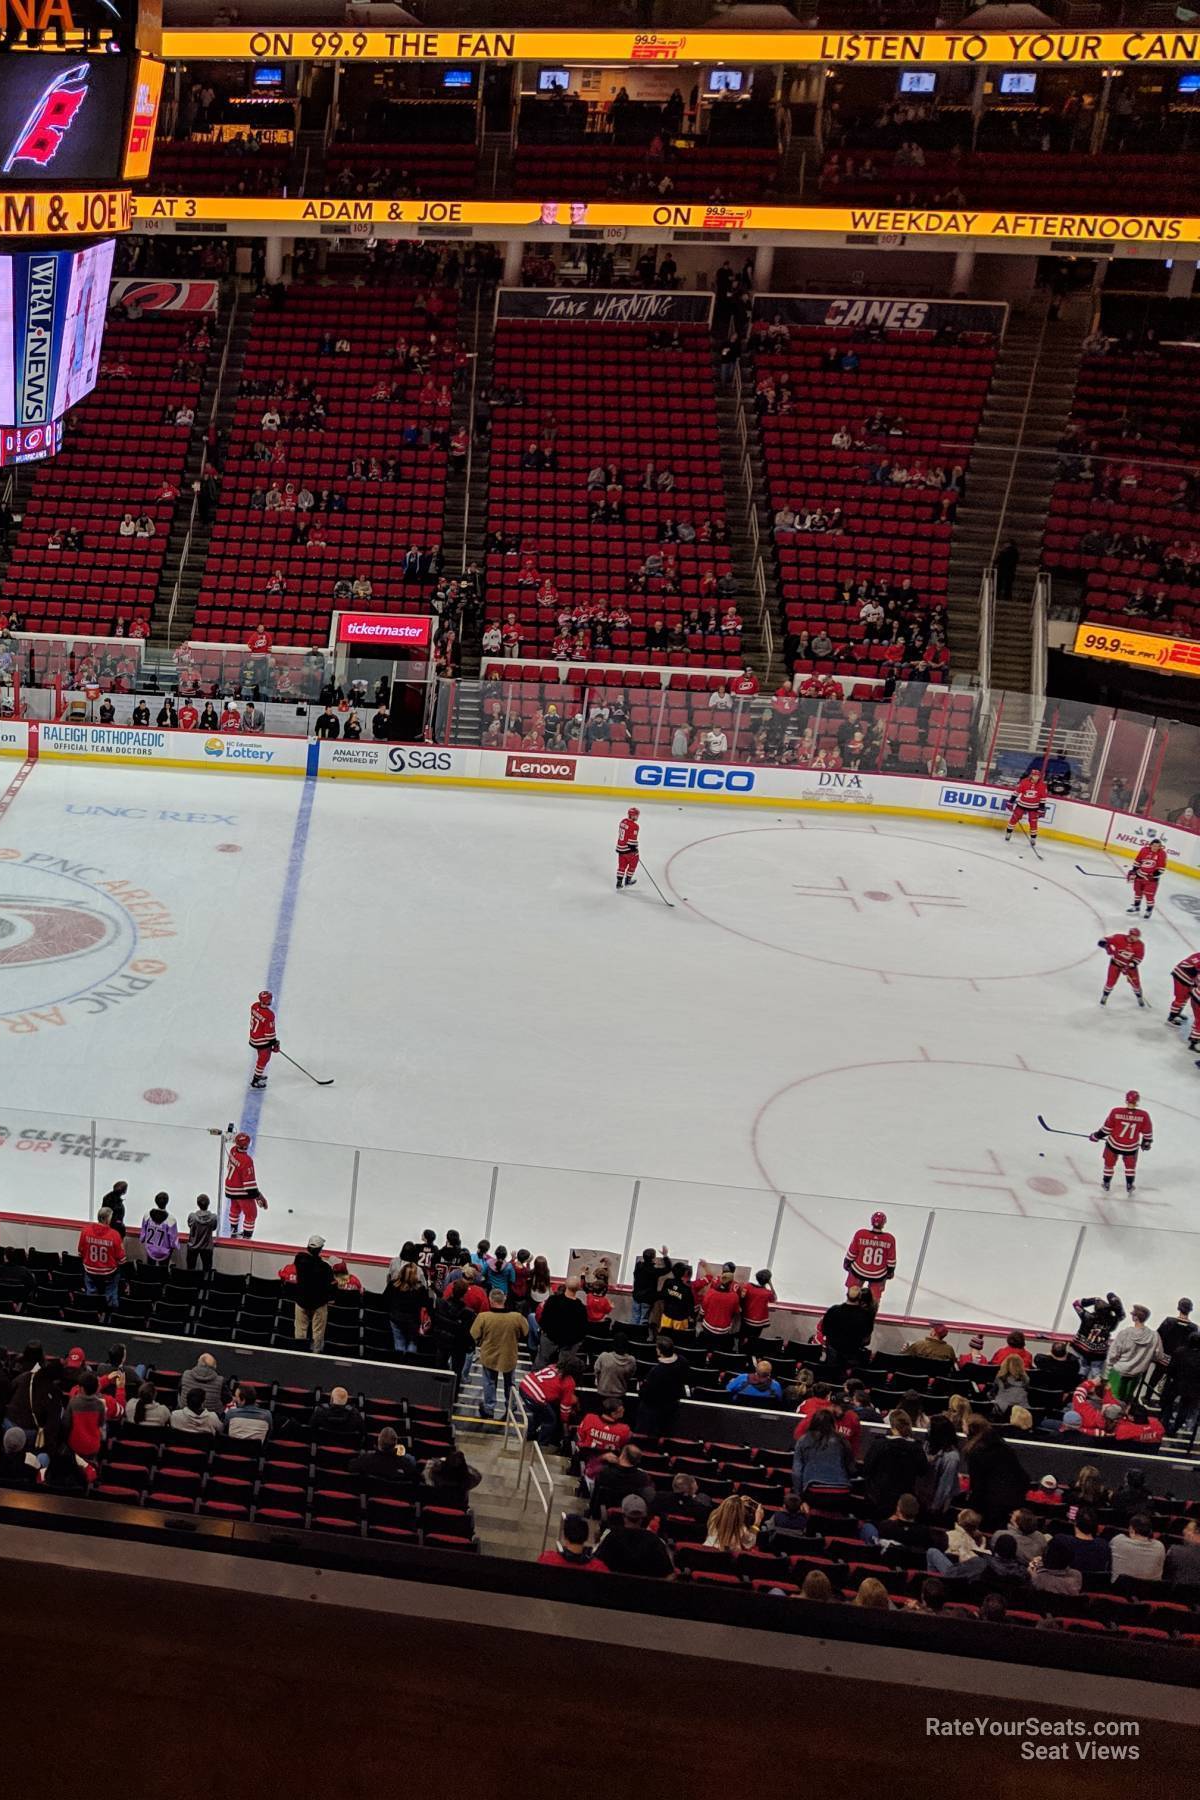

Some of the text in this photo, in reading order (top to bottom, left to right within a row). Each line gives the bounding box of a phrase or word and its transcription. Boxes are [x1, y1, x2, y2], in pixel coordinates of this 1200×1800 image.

[249, 33, 516, 57] ON 99.9 THE FAN
[819, 35, 926, 60] LISTEN
[944, 34, 988, 60] TO
[1007, 34, 1102, 60] YOUR
[46, 194, 69, 231] &
[76, 194, 117, 231] JOE
[152, 199, 178, 216] AT
[185, 199, 196, 217] 3
[302, 202, 462, 222] ADAM & JOE
[653, 207, 691, 226] ON
[851, 211, 1181, 240] WEEKDAY AFTERNOONS
[824, 300, 930, 328] CANES
[25, 259, 54, 420] WRAL NEWS
[347, 623, 423, 639] ticketmaster
[1084, 634, 1121, 653] 99.9
[43, 726, 165, 748] RALEIGH ORTHOPAEDIC
[54, 743, 152, 756] OFFICIAL TEAM DOCTORS
[226, 746, 274, 762] Lottery
[333, 748, 379, 759] ANALYTICS
[332, 756, 379, 765] POWERED BY
[511, 759, 572, 777] Lenovo
[634, 765, 755, 792] GEICO
[818, 772, 863, 788] DNA
[944, 790, 987, 807] BUD
[65, 804, 238, 826] UNC REX
[23, 852, 177, 941] PNC ARENA
[68, 973, 154, 1015] PNC
[19, 1129, 128, 1149] CLICK IT
[1120, 1121, 1137, 1139] 71
[15, 1140, 152, 1164] OR TICKET
[146, 1227, 165, 1247] 27
[89, 1244, 108, 1263] 86
[863, 1247, 883, 1266] 86
